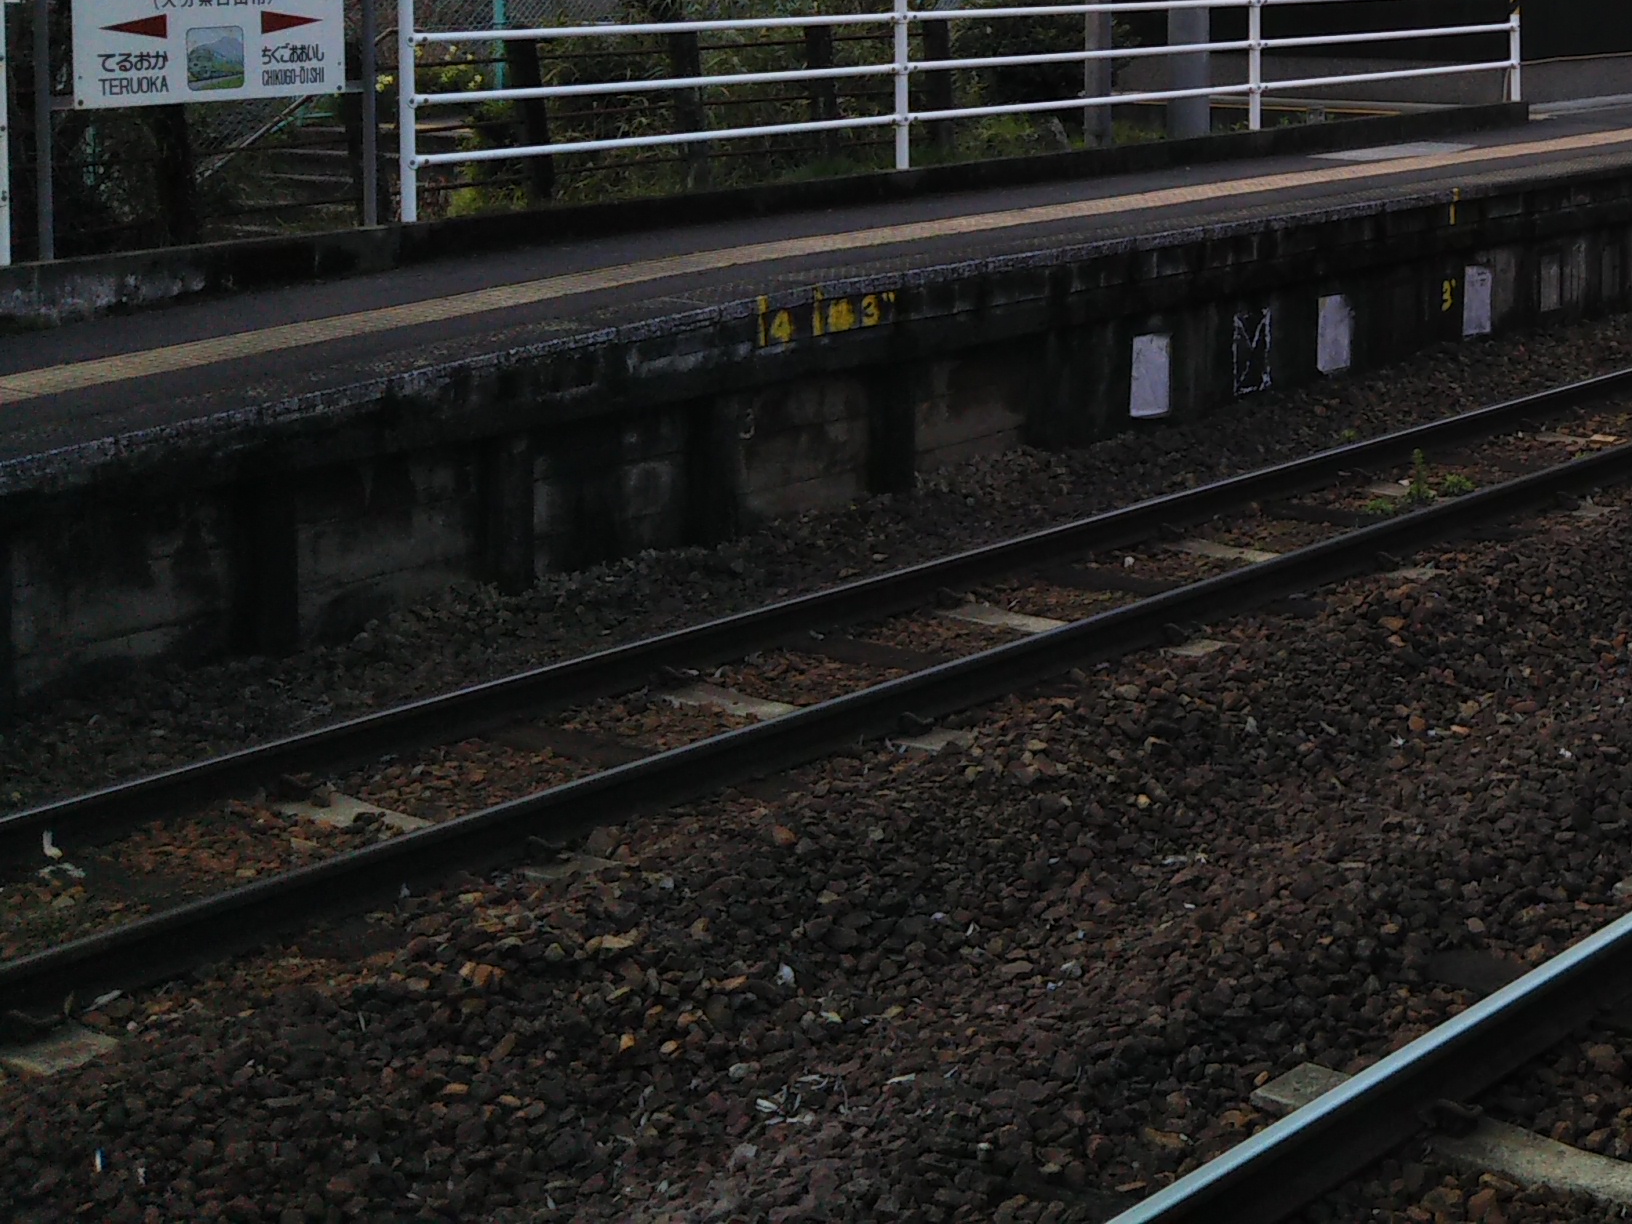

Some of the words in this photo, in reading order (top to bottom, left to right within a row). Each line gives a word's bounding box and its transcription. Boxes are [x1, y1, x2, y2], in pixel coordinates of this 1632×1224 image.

[97, 50, 169, 73] てるおか
[261, 42, 325, 65] ちくごおおいし
[98, 75, 170, 96] TERUOKA
